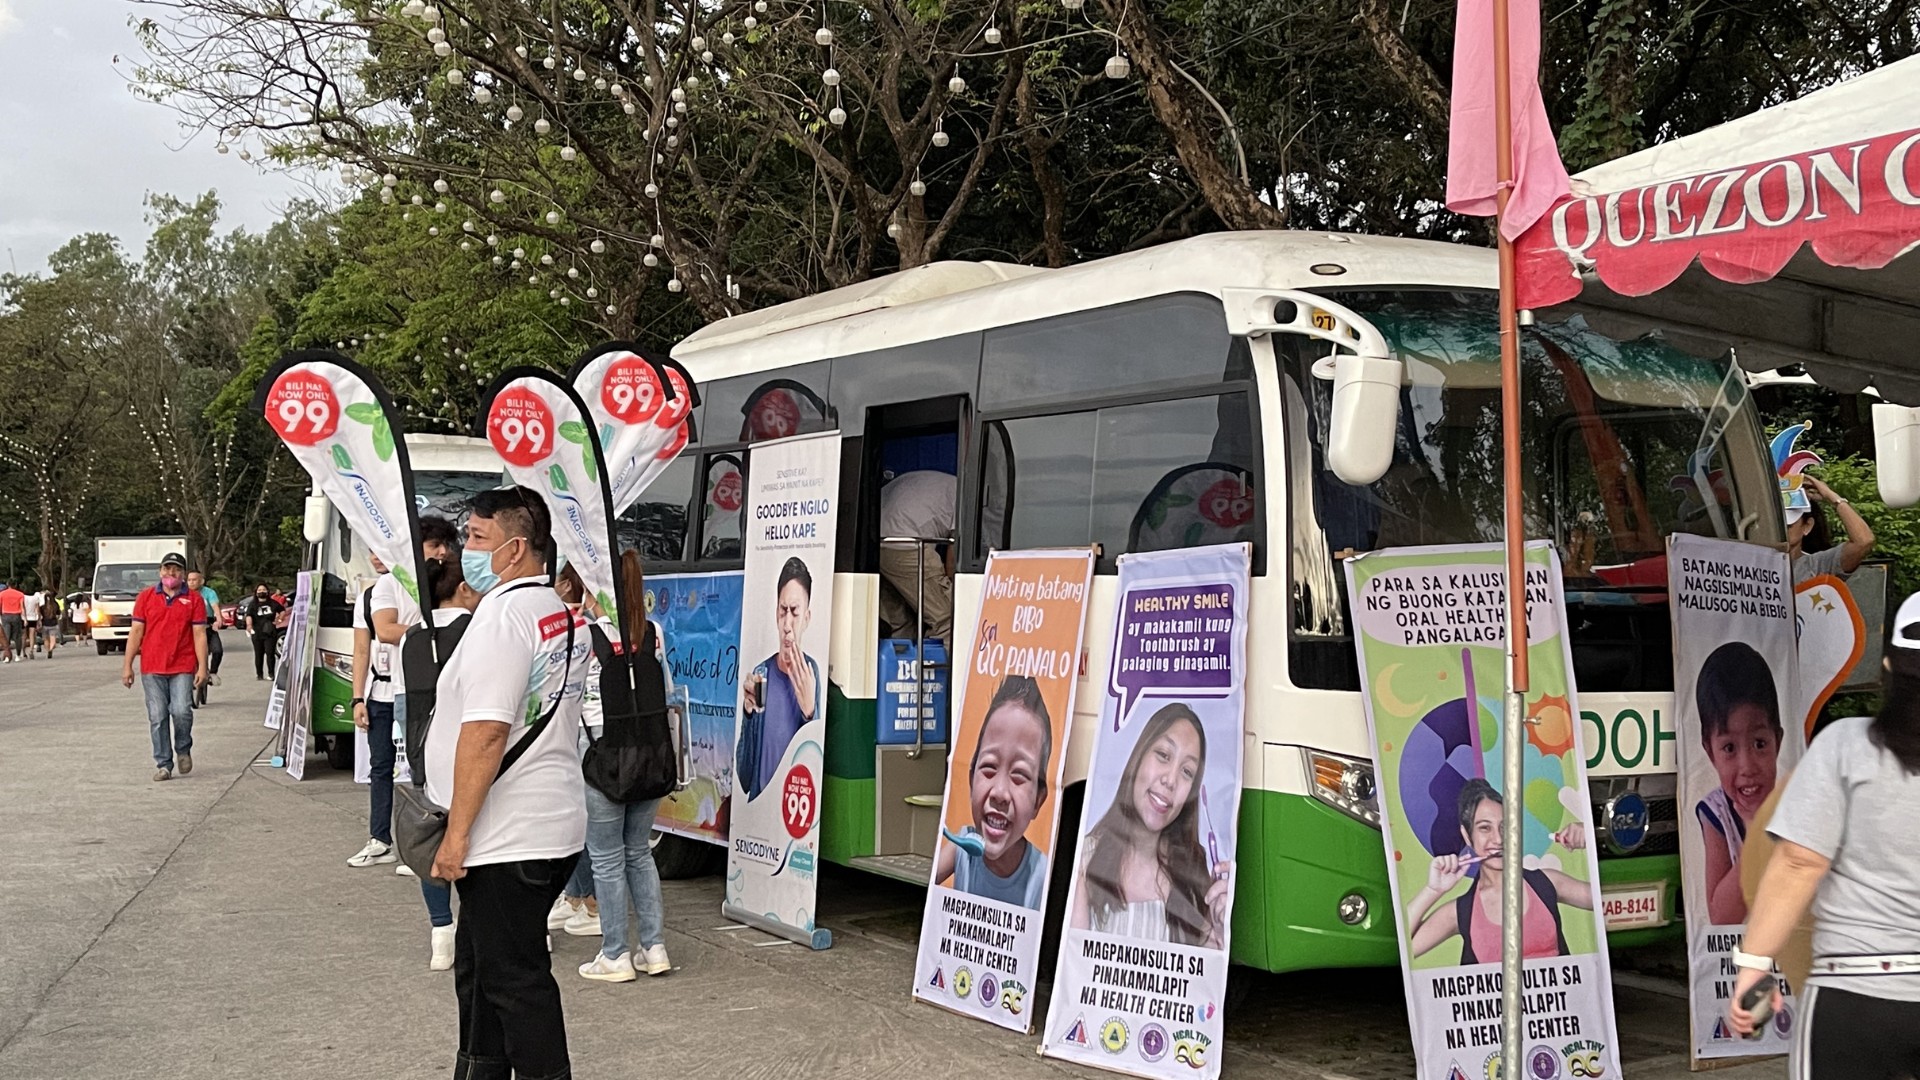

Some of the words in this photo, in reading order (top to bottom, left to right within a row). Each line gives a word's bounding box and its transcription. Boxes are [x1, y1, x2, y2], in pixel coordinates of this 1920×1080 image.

[1552, 143, 1870, 265] QUEZON
[285, 382, 303, 391] BILI
[610, 376, 633, 384] NOW
[634, 375, 654, 383] ONLY
[278, 390, 304, 399] NOW
[306, 391, 330, 400] ONLY
[506, 398, 523, 408] BILI
[500, 408, 523, 417] NOW
[525, 409, 544, 419] ONLY
[353, 482, 394, 539] SENSODYNE
[756, 501, 798, 519] GOODBYE
[800, 498, 830, 516] NGILO
[566, 504, 599, 564] SENSODYNE
[764, 524, 790, 541] HELLO
[792, 522, 817, 539] KAPE
[1372, 577, 1415, 593] PARA
[1422, 575, 1442, 591] SA
[1449, 569, 1548, 590] KALUSAN
[1682, 557, 1731, 577] BATANG
[1733, 564, 1780, 584] MAKISIG
[1036, 574, 1084, 603] batang
[1685, 575, 1763, 599] NAGSISIMULA
[1765, 586, 1782, 602] SA
[1134, 594, 1190, 613] HEALTHY
[1194, 592, 1229, 610] SMILE
[1366, 595, 1391, 611] NG
[1399, 593, 1457, 609] BUONG
[1678, 593, 1738, 613] MALUSOG
[1741, 600, 1758, 616] NA
[1760, 603, 1787, 619] BIBIG
[1012, 605, 1044, 633] BIBO
[1128, 622, 1141, 637] ay
[1143, 617, 1201, 635] makakamit
[1205, 617, 1231, 633] kung
[1396, 611, 1439, 627] ORAL
[1445, 608, 1505, 625] HEALTH
[1140, 637, 1200, 653] Toothbrush
[1203, 637, 1216, 653] ay
[976, 642, 1004, 677] QC
[1005, 646, 1071, 679] PANALO
[1122, 655, 1169, 673] palaging
[1173, 654, 1231, 672] ginagamit.
[1580, 709, 1677, 769] DOH
[735, 838, 780, 862] SENSODYNE
[942, 895, 1013, 930] MAGPAKONSULTA
[1014, 914, 1027, 934] SA
[948, 918, 1016, 952] PINAKAMALAPIT
[940, 936, 952, 956] NA
[953, 940, 984, 965] HEALTH
[985, 950, 1018, 975] CENTER
[1082, 939, 1184, 973] MAGPAKONSULTA
[1188, 955, 1205, 977] SA
[1001, 979, 1027, 996] HEALTHY
[1092, 964, 1189, 998] PINAKAMALAPIT
[1432, 966, 1558, 999] MAGPAKOULTA
[1561, 965, 1582, 986] SA
[1714, 981, 1729, 999] NA
[1080, 986, 1097, 1007] NA
[1100, 989, 1146, 1015] HEALTH
[1149, 998, 1195, 1024] CENTER
[1452, 991, 1567, 1022] PINAKAALAPIT
[1172, 1029, 1212, 1047] HEALTHY
[1445, 1028, 1466, 1050] NA
[1528, 1015, 1581, 1040] CENTER
[1174, 1041, 1208, 1069] QC
[1561, 1039, 1605, 1058] HEALTHY
[1567, 1052, 1605, 1078] QC
